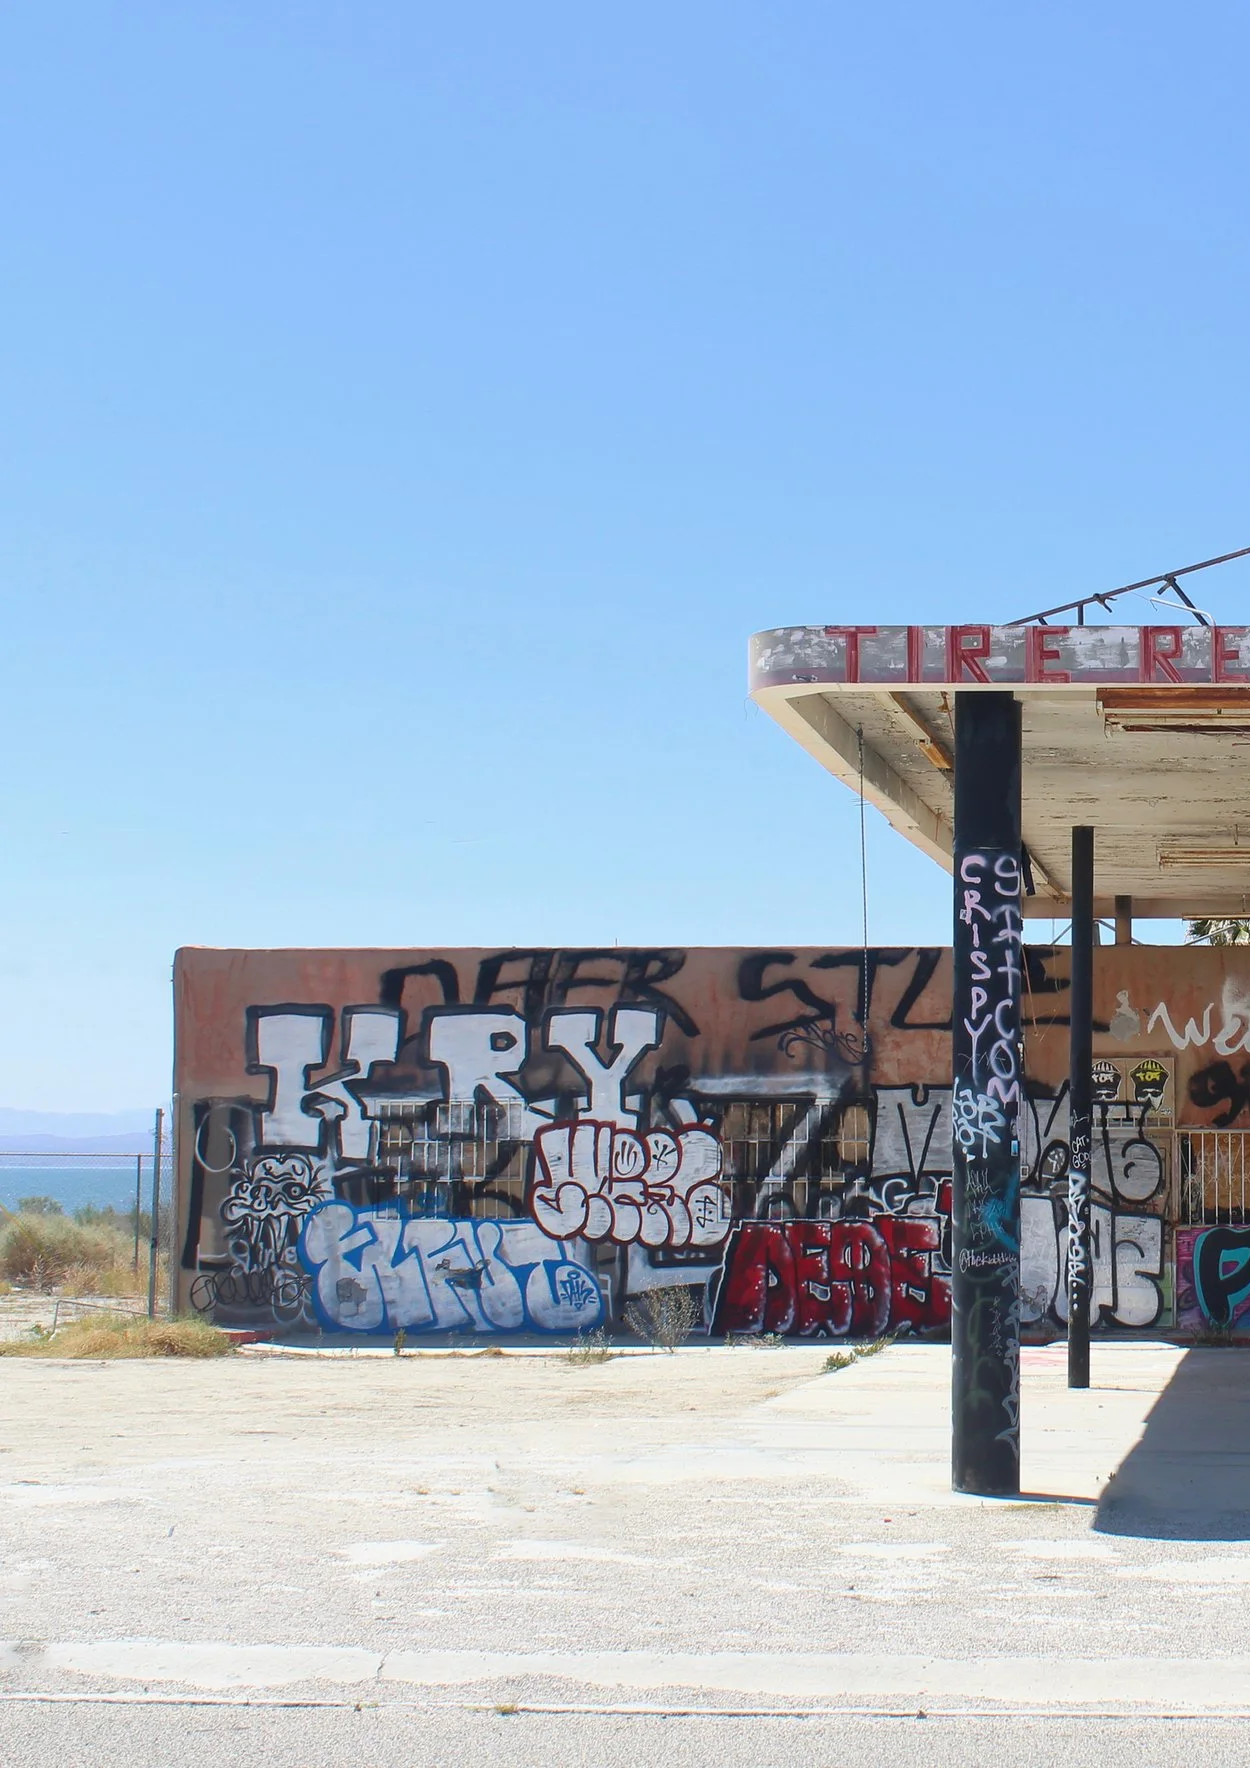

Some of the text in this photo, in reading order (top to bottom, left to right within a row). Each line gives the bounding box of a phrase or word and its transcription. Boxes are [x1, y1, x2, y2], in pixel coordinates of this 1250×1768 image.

[825, 624, 1072, 684] TIRE
[960, 855, 992, 1087] CRISPY
[247, 1003, 664, 1165] KRY
